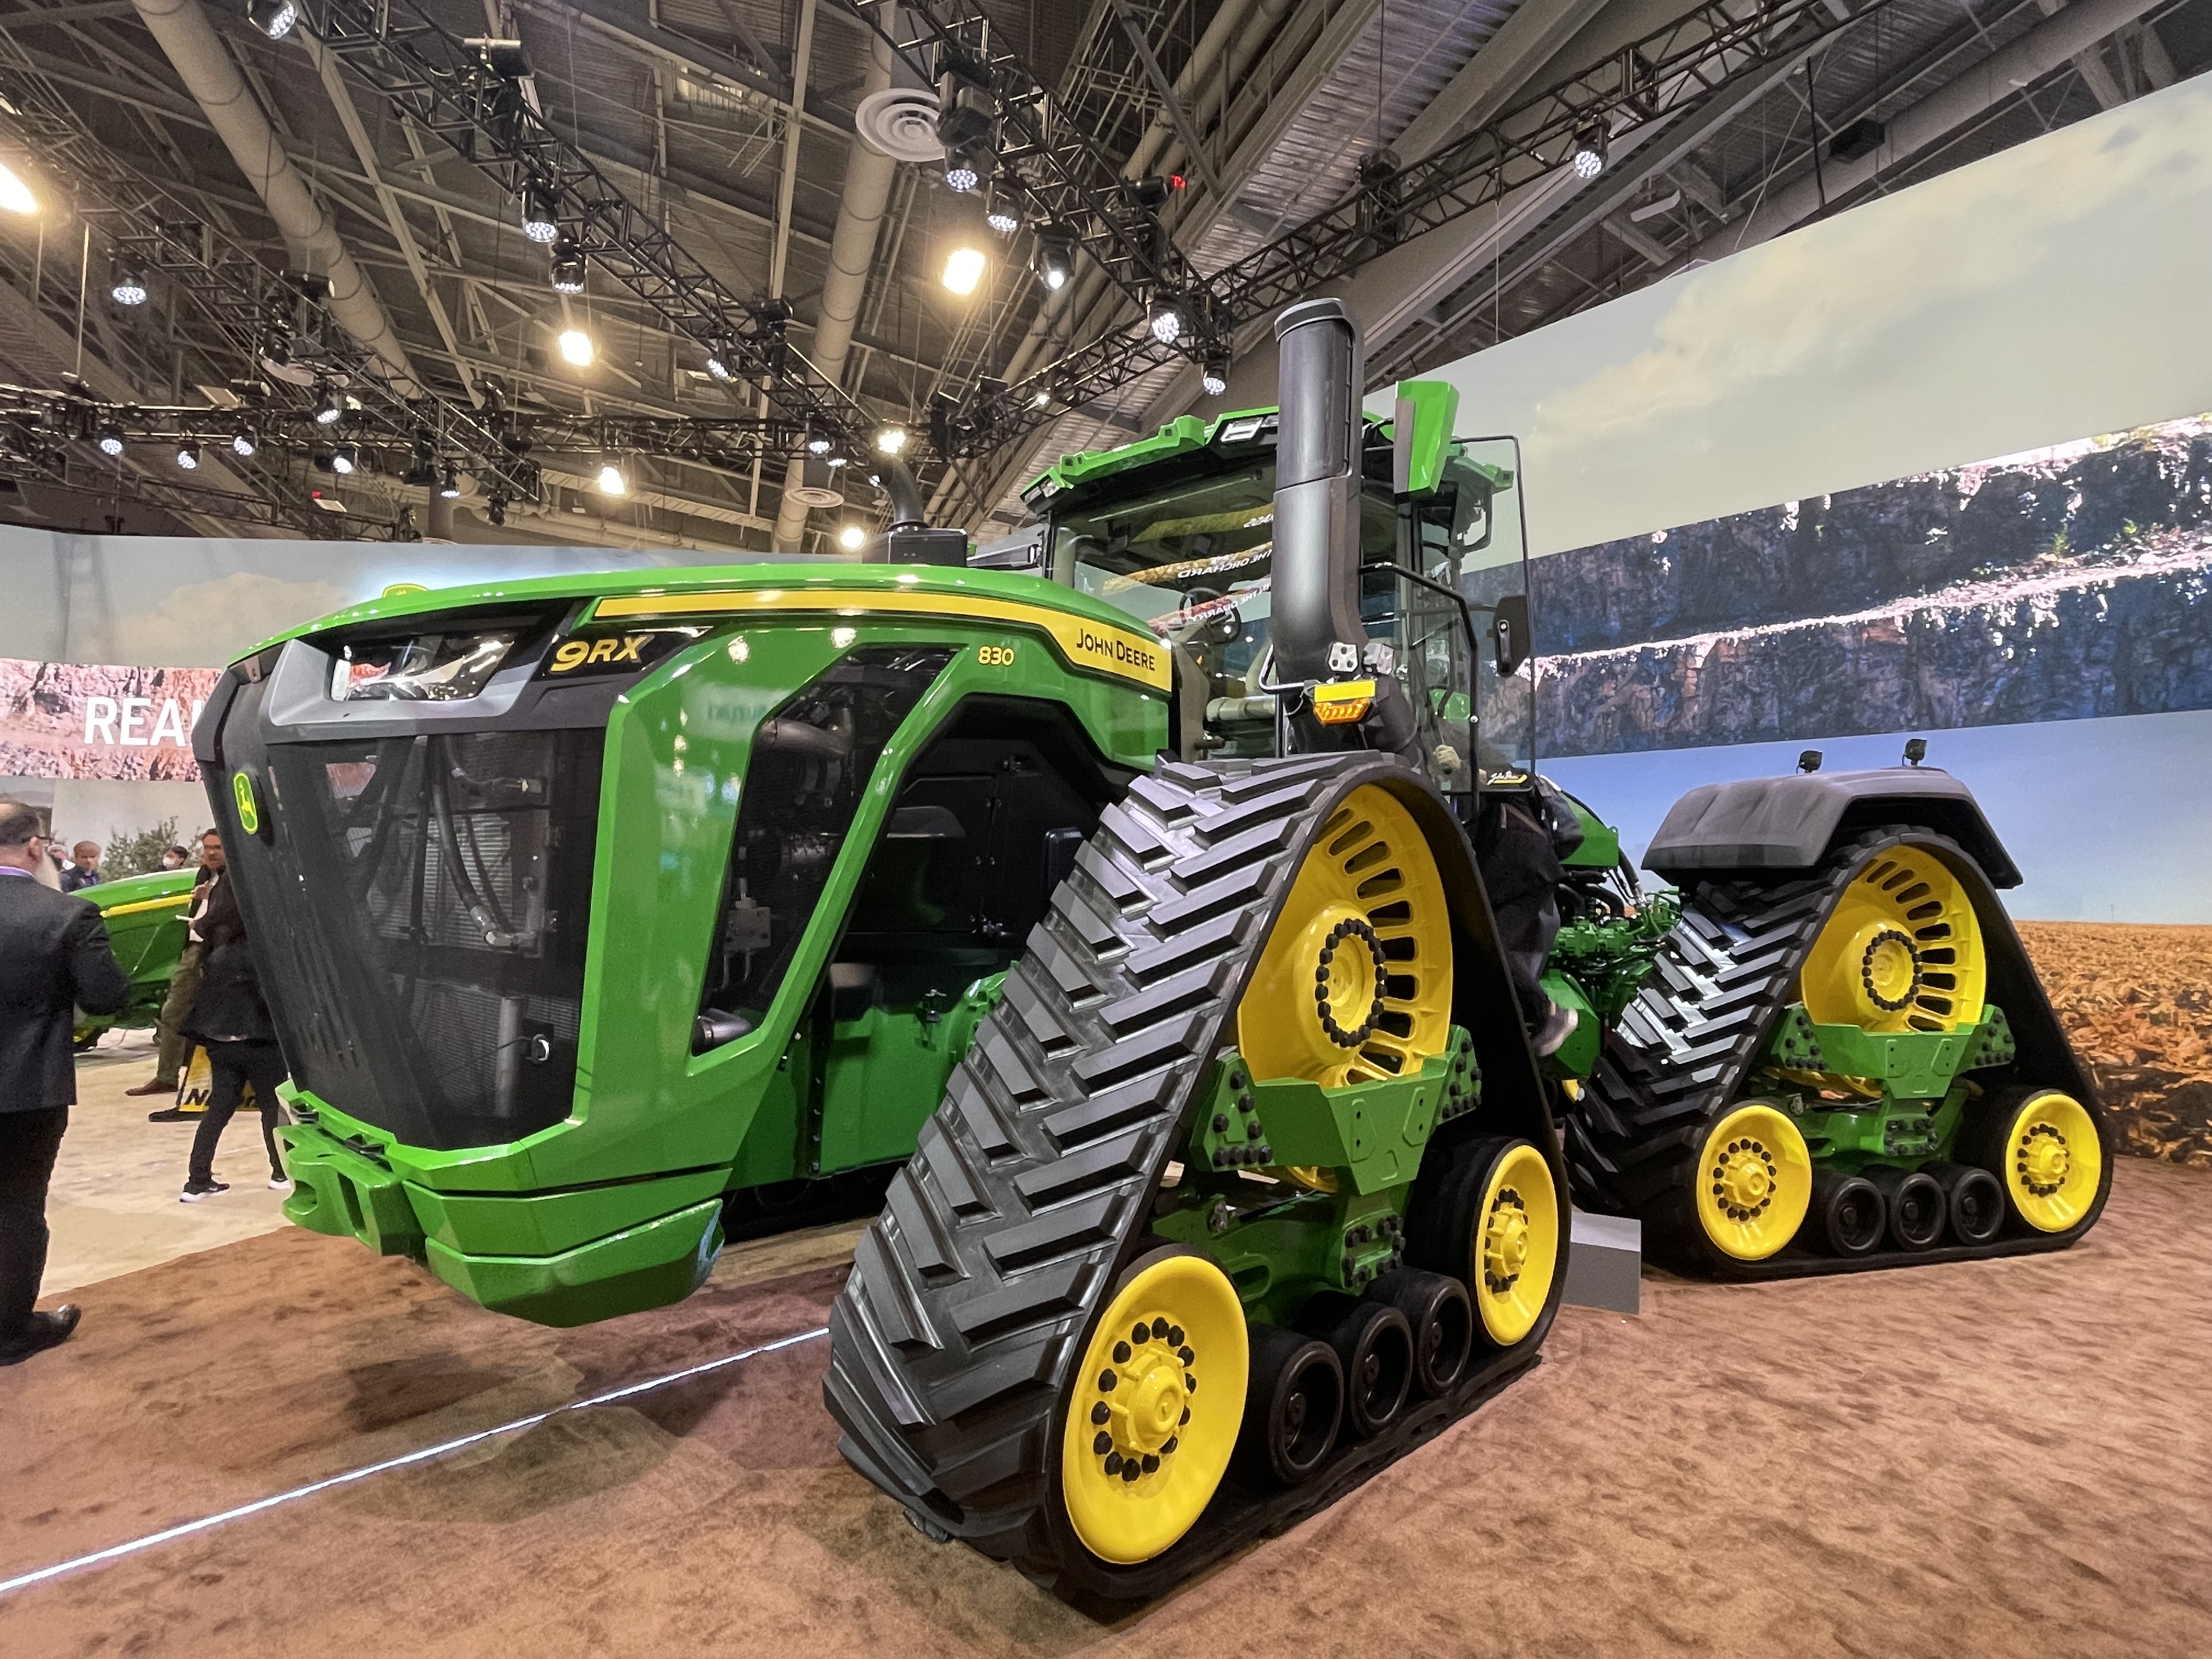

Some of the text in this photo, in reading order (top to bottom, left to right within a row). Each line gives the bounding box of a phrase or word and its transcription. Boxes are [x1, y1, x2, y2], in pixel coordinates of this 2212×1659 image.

[550, 635, 652, 674] 9RX
[978, 645, 1015, 666] 830
[1076, 628, 1155, 672] JOHN DEERE
